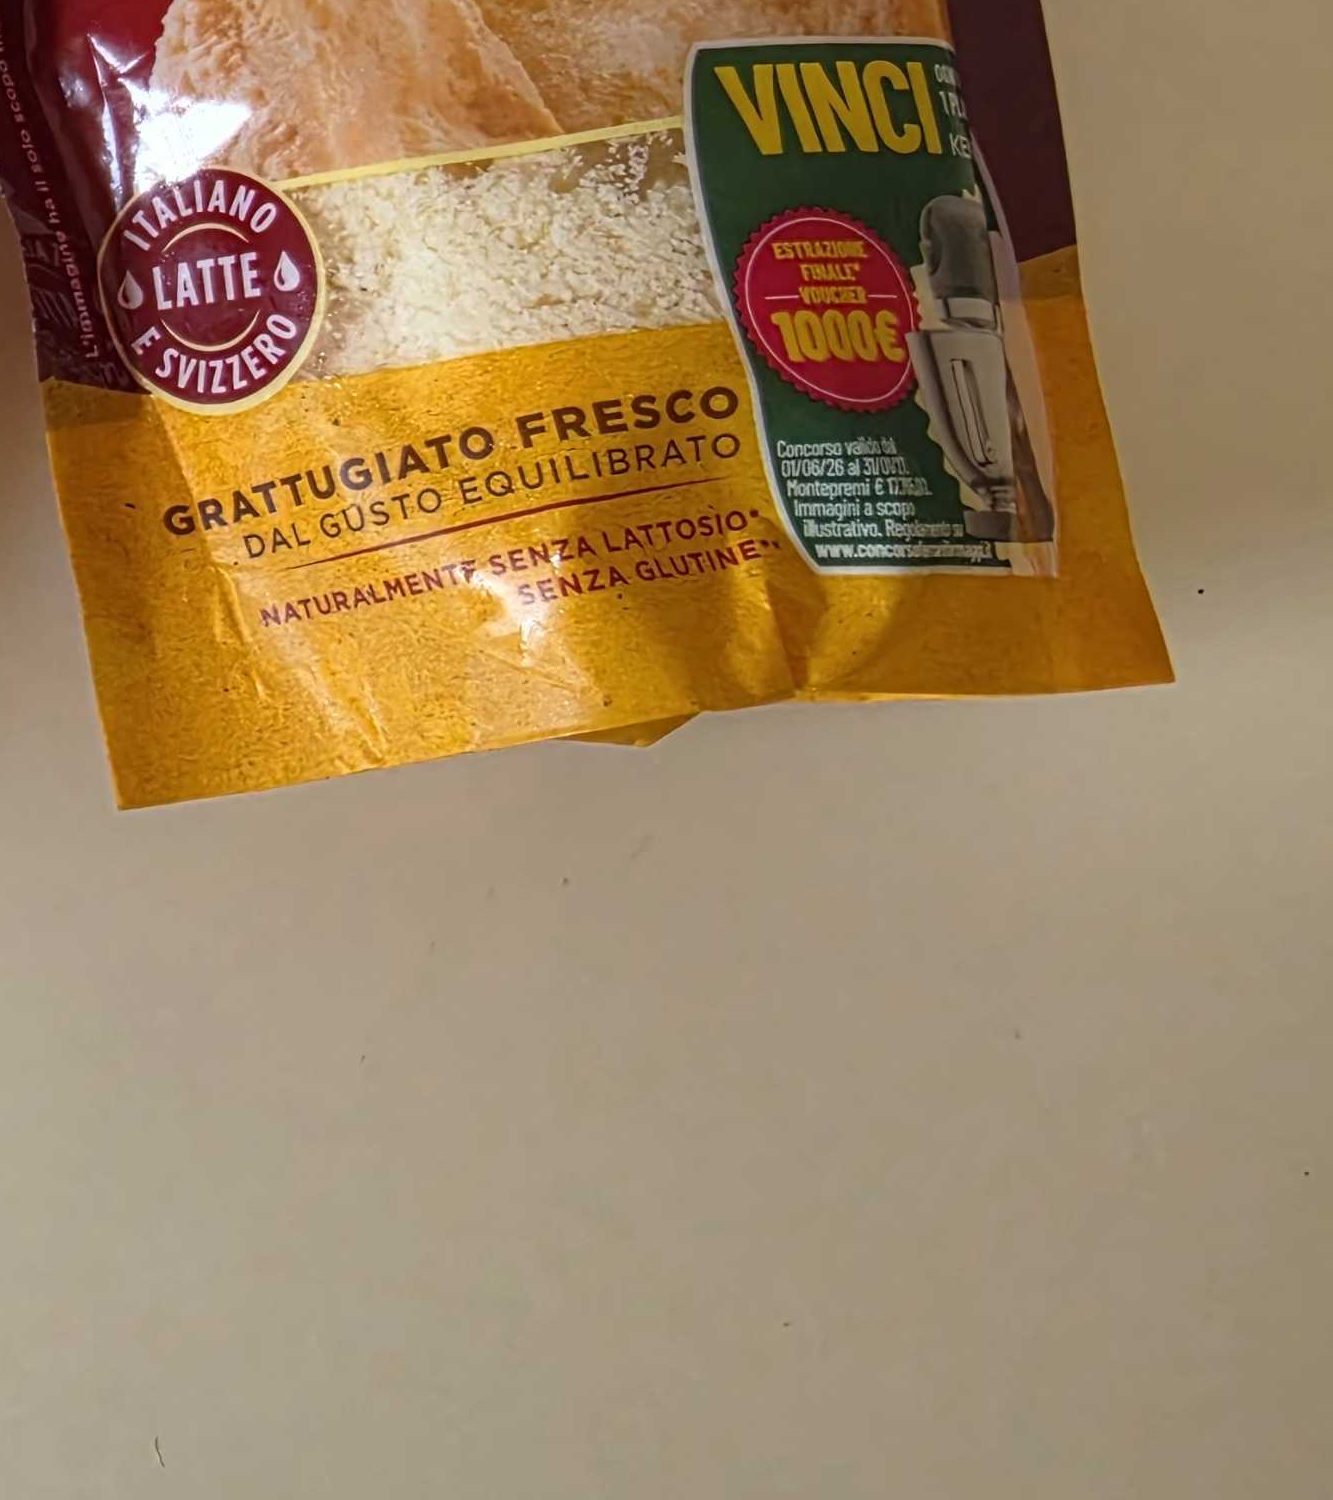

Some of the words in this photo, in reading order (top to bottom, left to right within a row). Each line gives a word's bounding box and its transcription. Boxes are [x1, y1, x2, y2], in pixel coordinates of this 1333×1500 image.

[713, 59, 943, 157] VINCI
[123, 179, 277, 251] ITALIANO
[151, 251, 262, 311] LATTE
[130, 326, 162, 356] E
[154, 313, 297, 395] SVIZZERO
[770, 308, 906, 363] 1000€
[162, 426, 494, 537] GRATTUGIATO
[515, 386, 740, 450] FRESCO
[776, 440, 842, 459] Concorso
[243, 522, 312, 559] DAL
[319, 487, 442, 538] GUSTO
[458, 432, 741, 505] EQUILIBRATO
[786, 478, 871, 499] Montepremi
[794, 500, 861, 521] Immagini
[863, 503, 873, 516] a
[260, 559, 476, 628] NATURALMENTE
[489, 535, 597, 576] SENZA
[517, 566, 629, 606] SENZA
